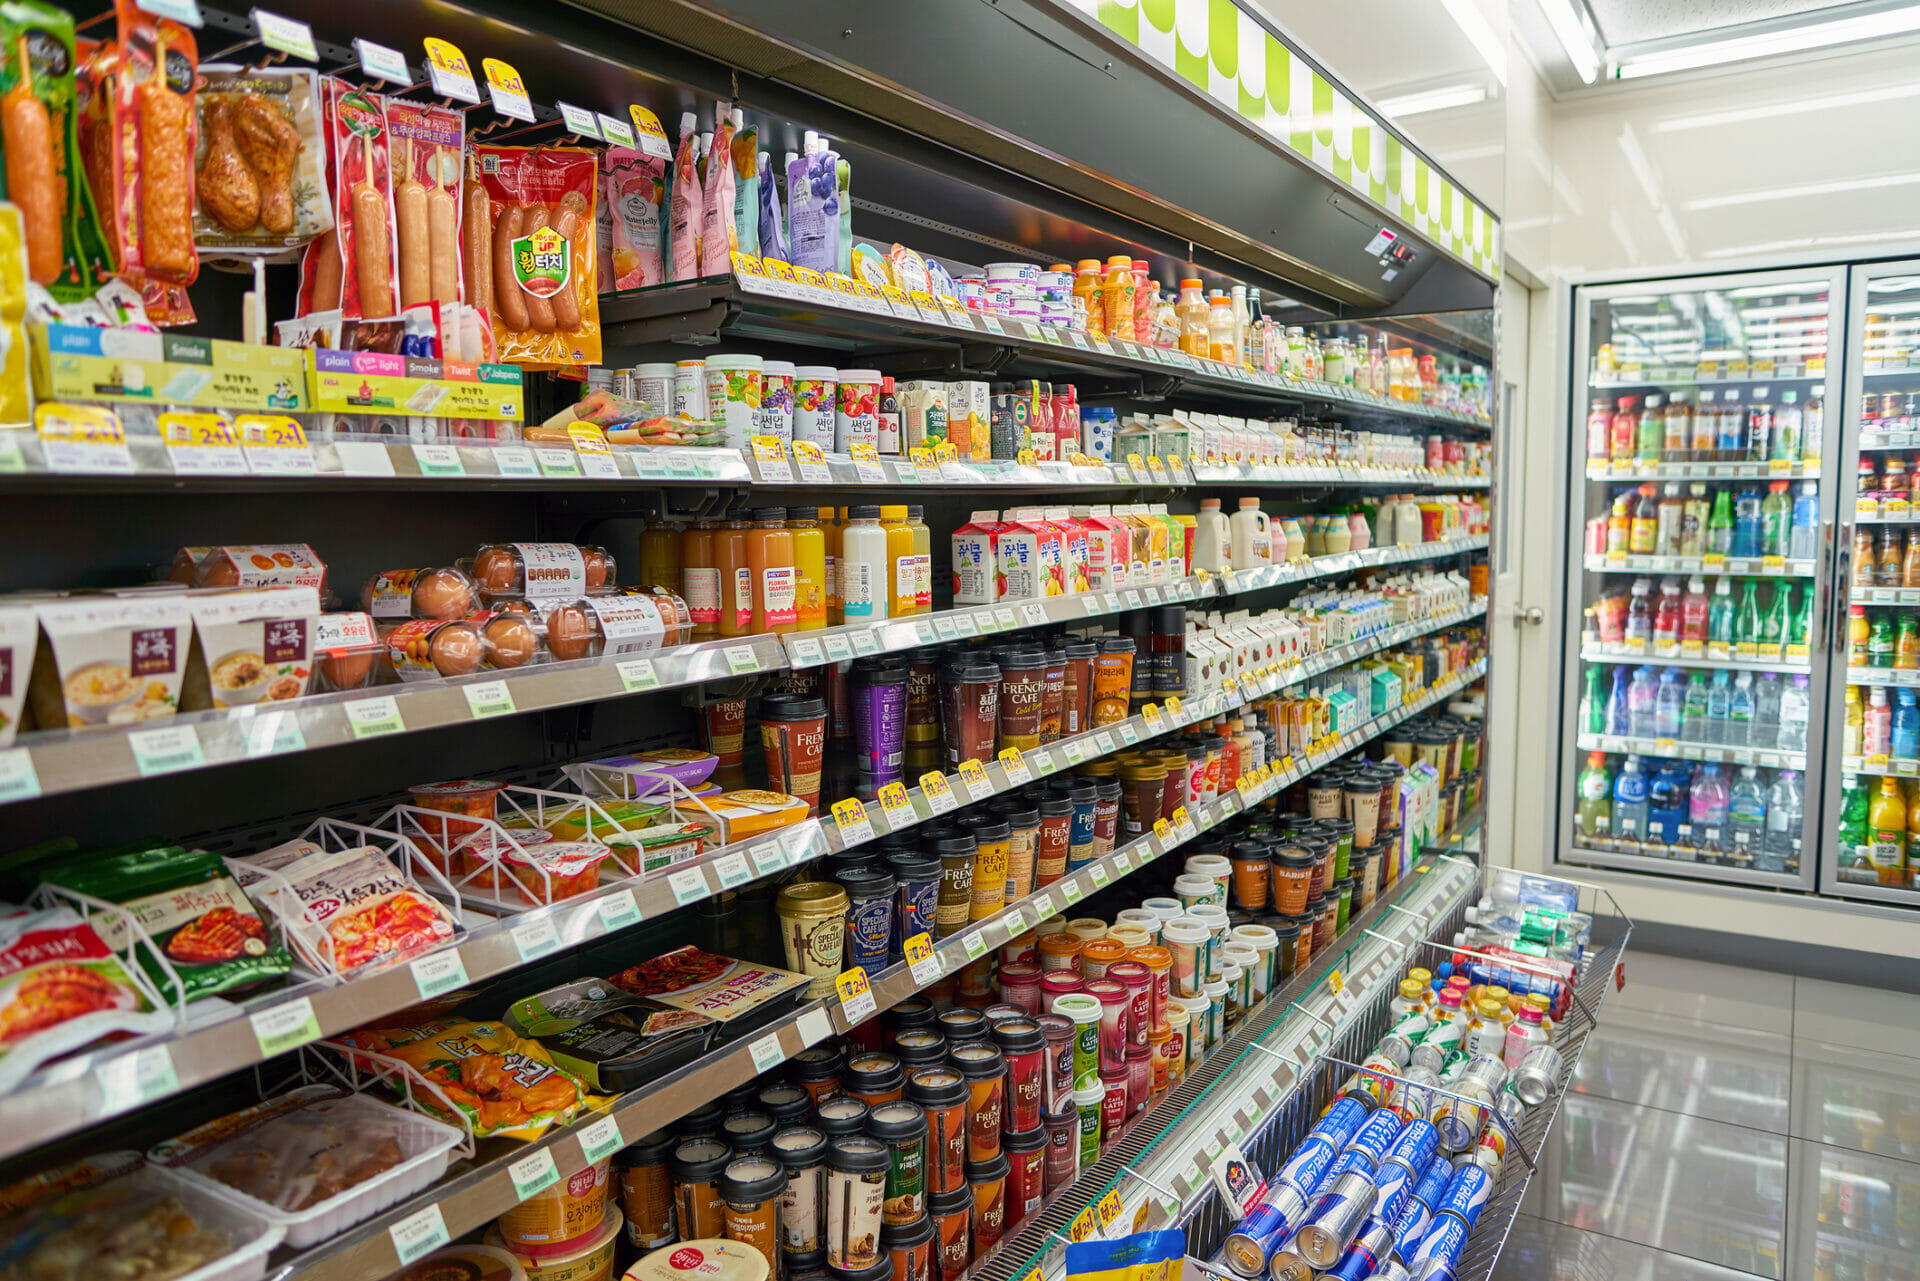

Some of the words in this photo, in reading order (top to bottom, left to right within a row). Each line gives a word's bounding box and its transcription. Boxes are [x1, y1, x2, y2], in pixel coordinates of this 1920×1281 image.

[504, 77, 524, 92] 2+1
[649, 121, 663, 134] 2+1
[539, 243, 554, 251] UP
[748, 262, 764, 275] 2+1
[781, 268, 796, 281] 2+1
[1019, 270, 1034, 279] BIO
[811, 273, 827, 287] 2+1
[841, 281, 856, 294] 2+1
[1058, 278, 1071, 286] BIO
[996, 294, 1009, 302] BIO
[326, 355, 349, 368] plain
[379, 360, 399, 372] light
[409, 363, 439, 374] Smoke
[451, 366, 471, 376] Twist
[761, 415, 784, 429] 썬업
[852, 420, 872, 432] 썬업
[201, 422, 233, 444] 2+1
[272, 424, 303, 444] 2+1
[768, 442, 783, 459] 2+1
[808, 448, 822, 462] 2+1
[922, 452, 936, 466] 2+1
[959, 540, 982, 563] 쥬시쿨
[1004, 540, 1029, 563] 쥬시쿨
[1041, 536, 1060, 564] 쥬시쿨
[1071, 534, 1087, 561] 쥬시쿨
[268, 630, 303, 648] 본죽
[782, 676, 818, 688] RENCH
[1003, 680, 1044, 694] FRENCH
[1011, 694, 1038, 704] CAFE
[1016, 705, 1031, 715] Cold
[1011, 752, 1024, 770] 2+1
[972, 764, 985, 781] 2+1
[934, 774, 949, 793] 2+1
[893, 786, 908, 806] 2+1
[849, 801, 865, 822] 2+1
[920, 937, 933, 957] 2+1
[853, 970, 868, 993] 2+1
[1104, 1100, 1123, 1109] LATTE
[1081, 1120, 1098, 1129] LATTE
[1362, 1110, 1389, 1144] SWEAT
[570, 1174, 594, 1193] 햇반
[1109, 1194, 1120, 1216] 2+1
[1082, 1208, 1094, 1231] 2+1
[672, 1251, 698, 1268] 햇반
